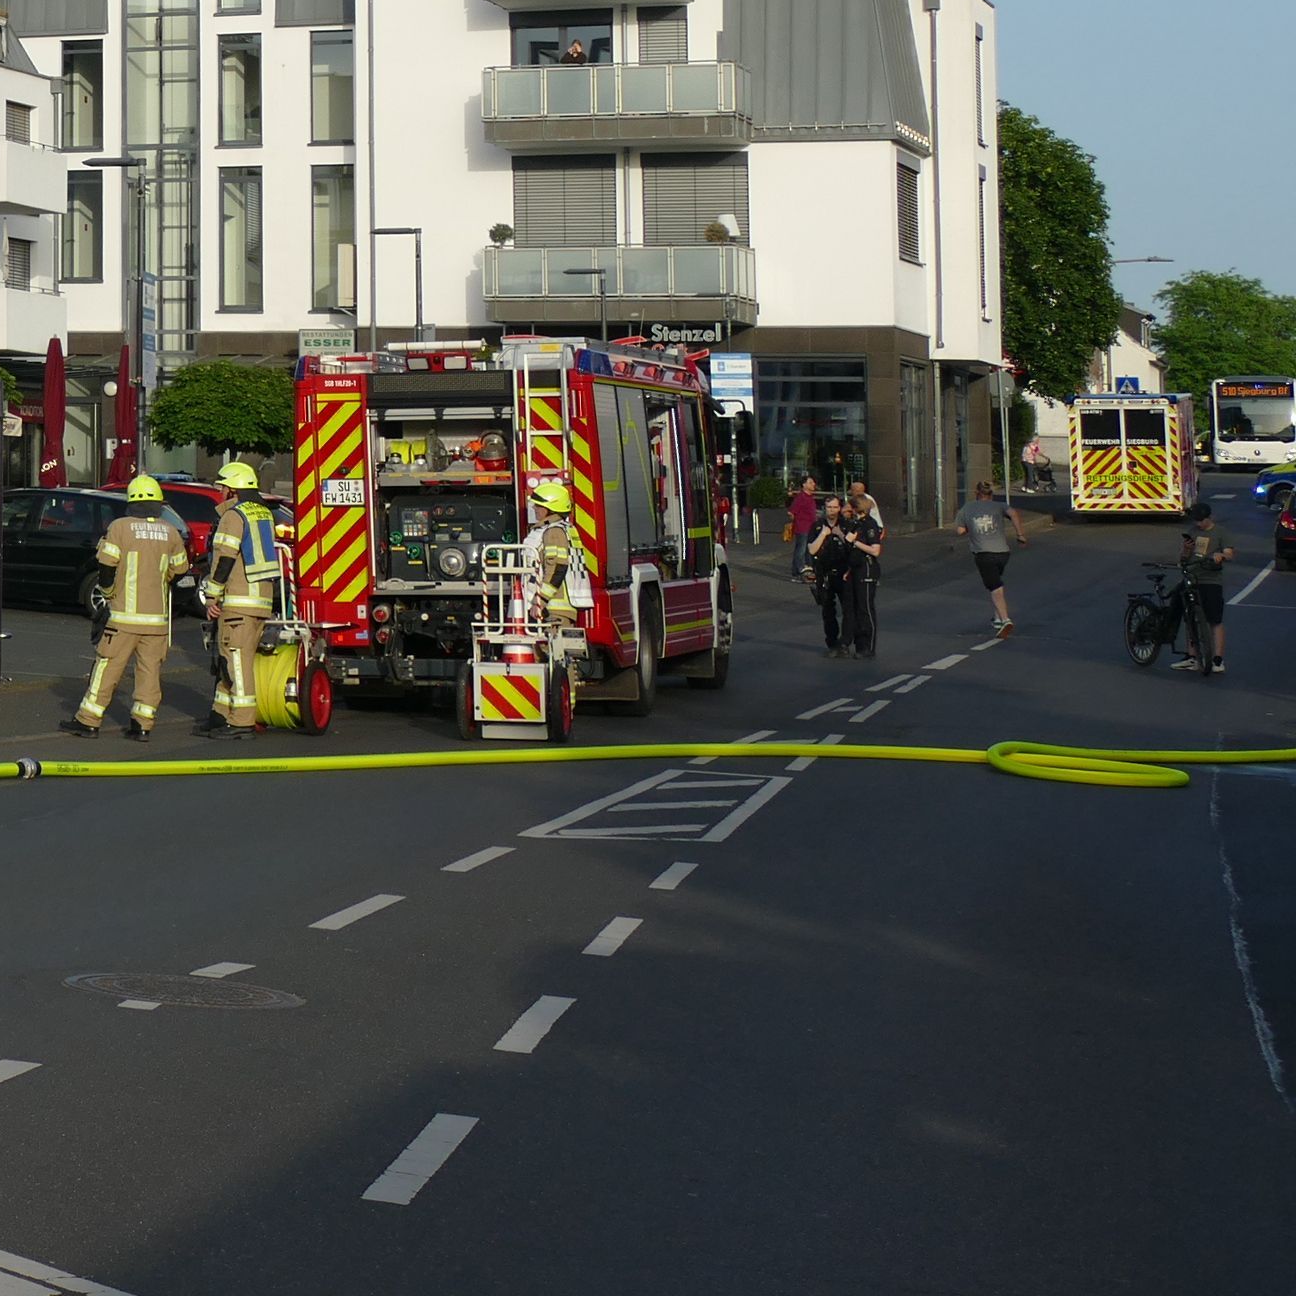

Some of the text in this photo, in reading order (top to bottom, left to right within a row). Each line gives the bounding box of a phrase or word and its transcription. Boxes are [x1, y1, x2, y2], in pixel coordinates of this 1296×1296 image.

[651, 322, 722, 342] Stenzel
[304, 338, 351, 347] ESSER
[1237, 387, 1277, 397] Siegburg
[1086, 474, 1165, 482] RETTUNGSDIENST
[338, 481, 350, 492] SU
[339, 492, 363, 503] 1431
